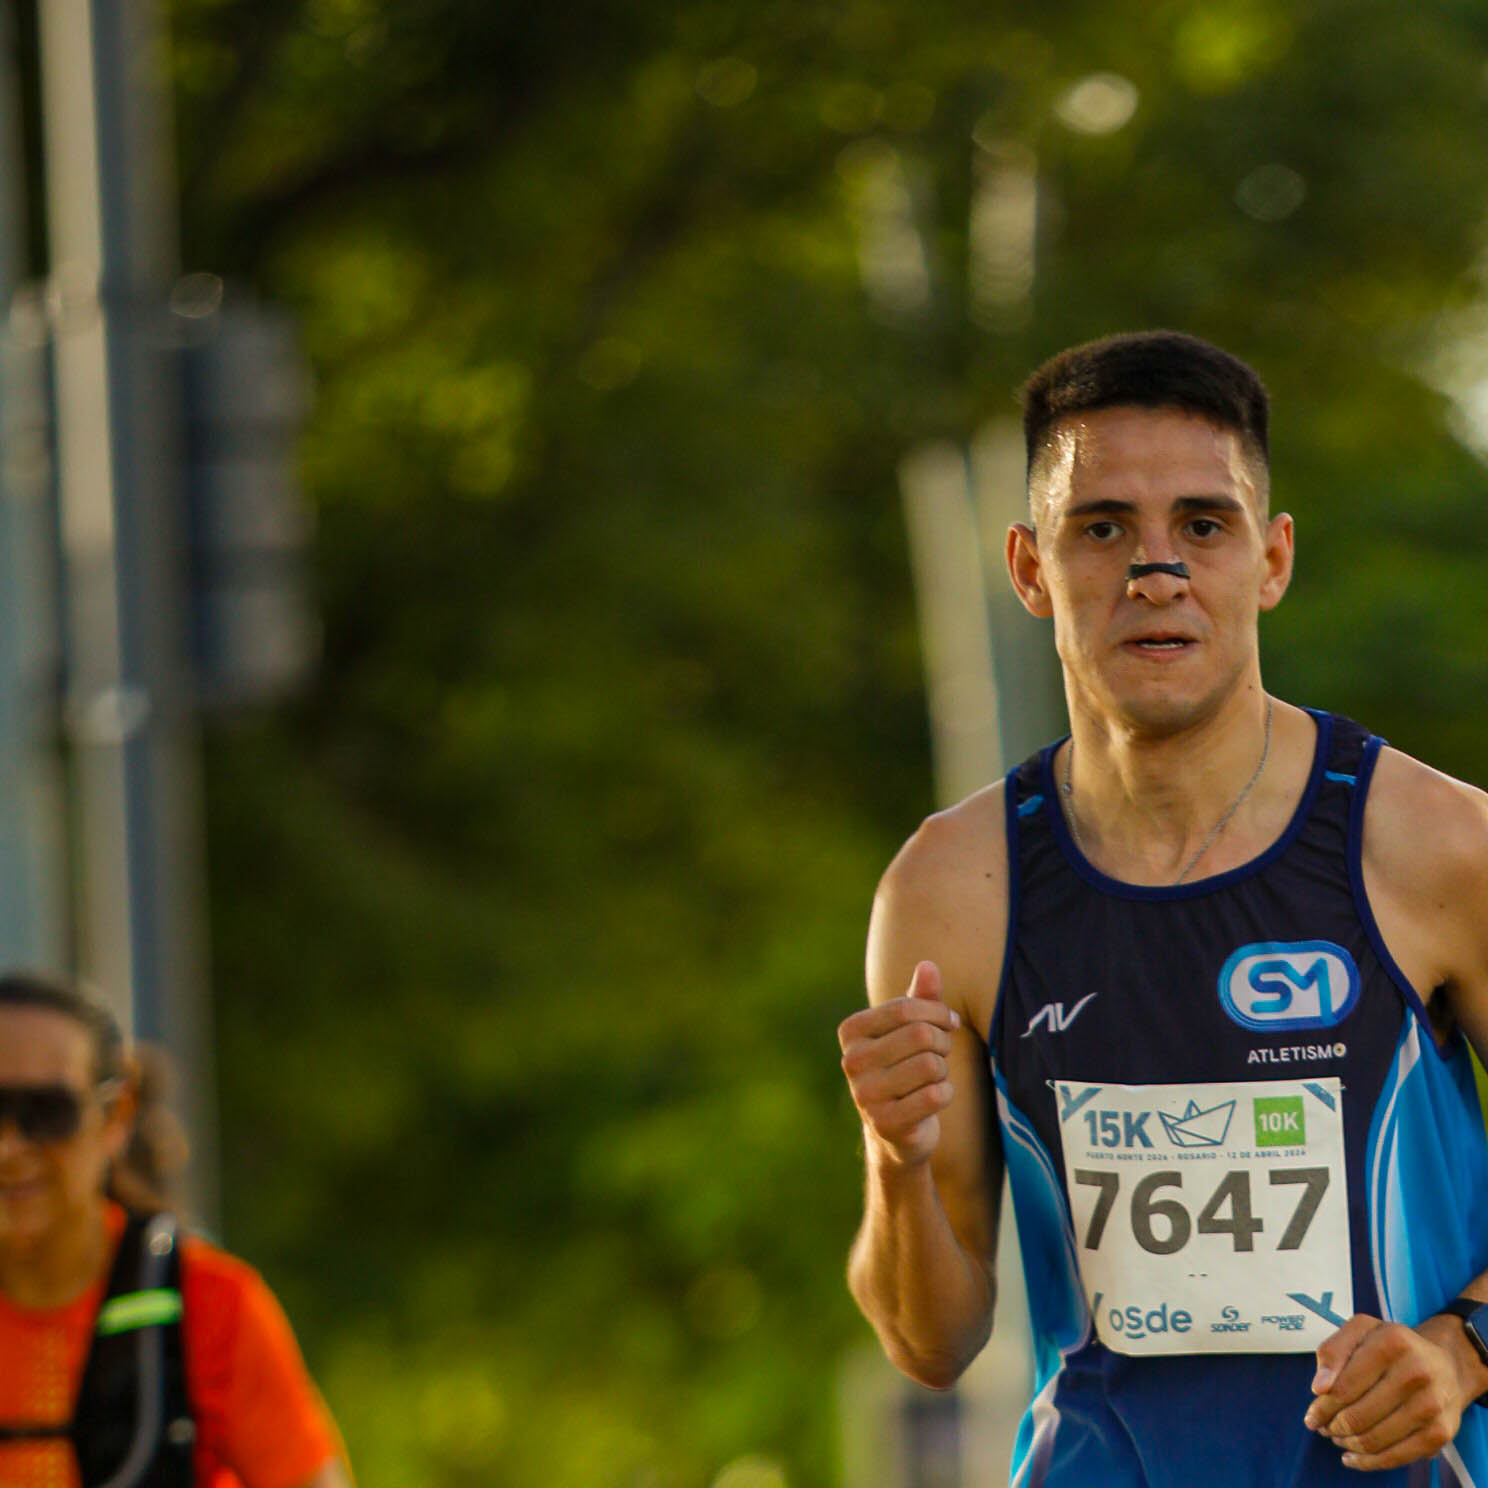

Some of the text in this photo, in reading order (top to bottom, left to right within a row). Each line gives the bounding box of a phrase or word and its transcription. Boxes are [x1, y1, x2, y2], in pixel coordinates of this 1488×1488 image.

[1248, 957, 1333, 1028] SM
[1247, 1042, 1346, 1064] ATLETISMO
[1083, 1109, 1154, 1148] 15K
[1258, 1110, 1299, 1132] 10K
[1086, 1151, 1114, 1160] PUERTO
[1117, 1152, 1143, 1161] NORTE
[1177, 1151, 1217, 1160] ROSARIO
[1254, 1150, 1281, 1158] ABRIL
[1074, 1166, 1330, 1255] 7647
[1109, 1302, 1193, 1338] osde
